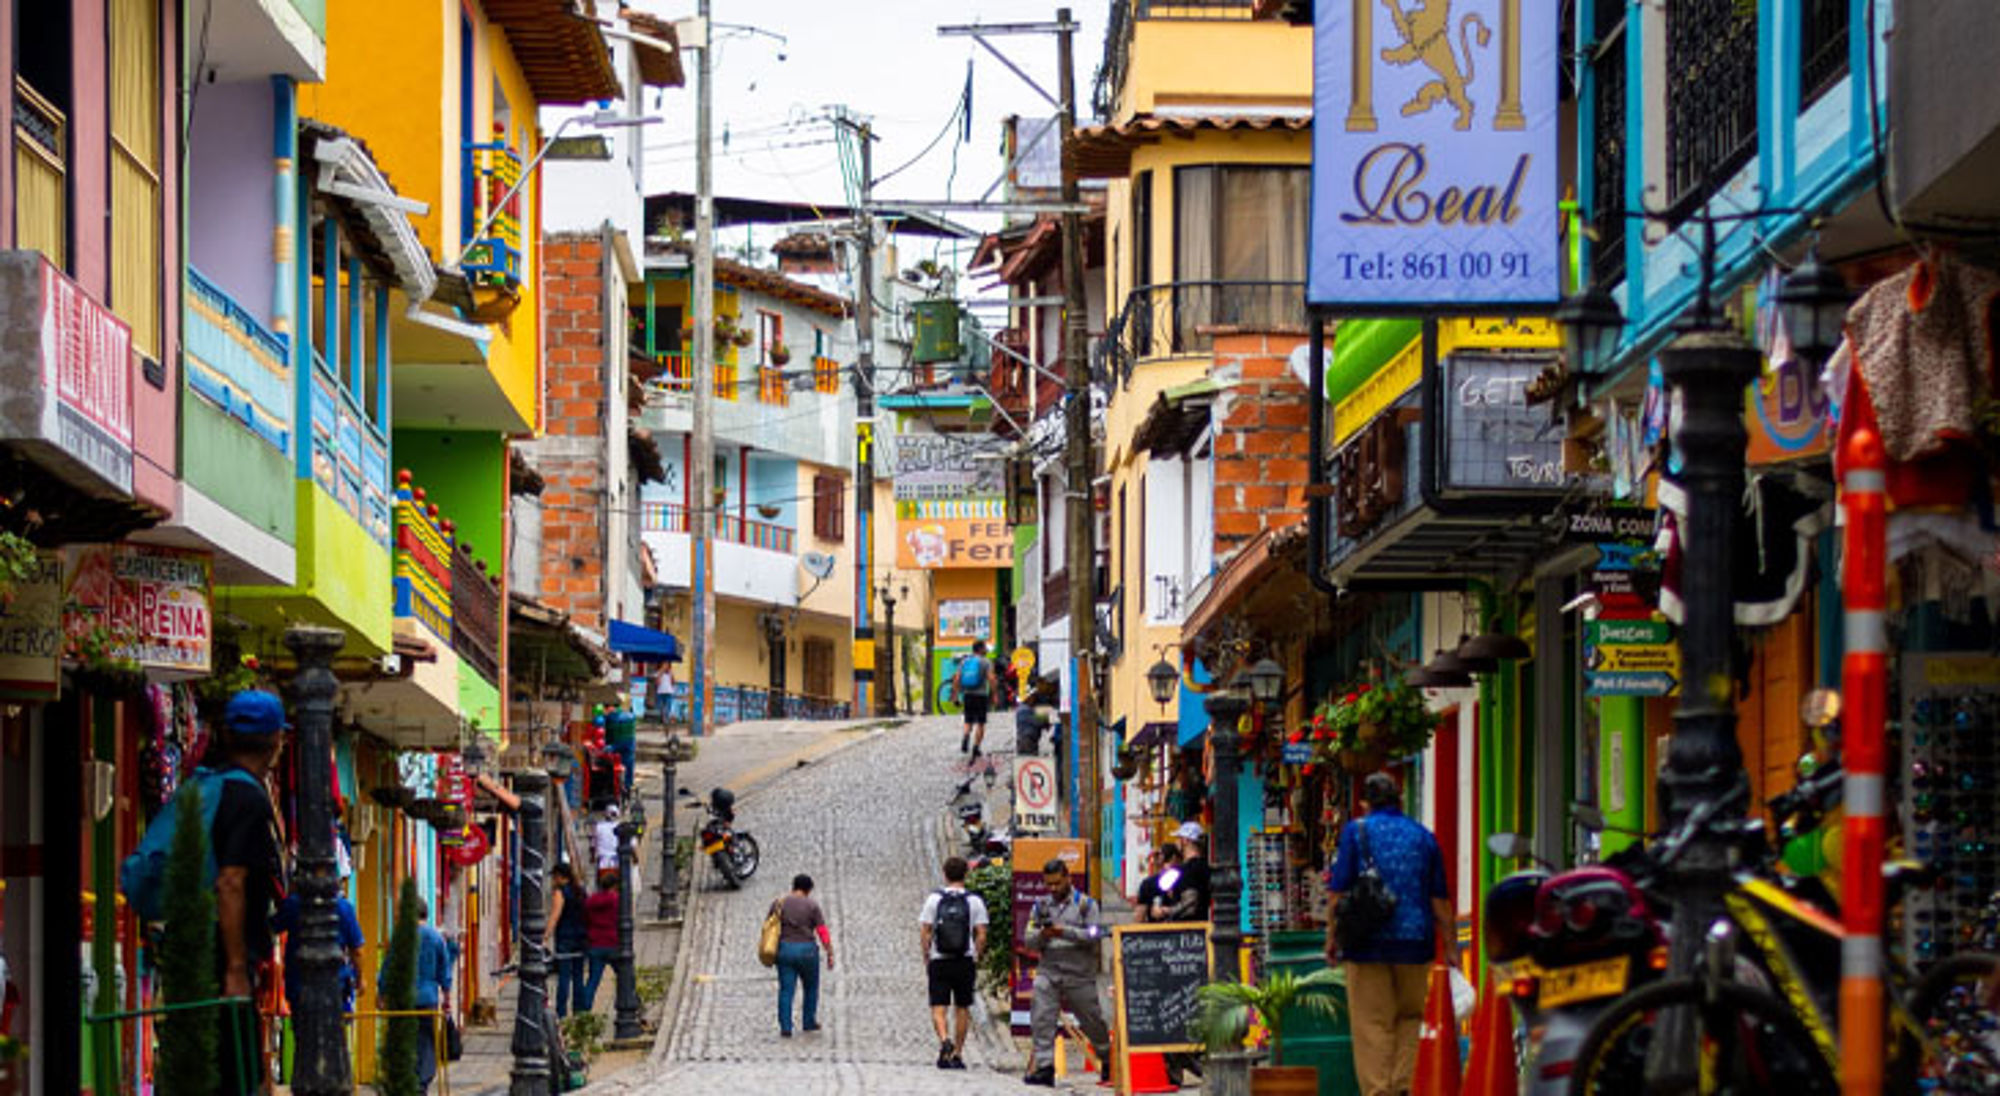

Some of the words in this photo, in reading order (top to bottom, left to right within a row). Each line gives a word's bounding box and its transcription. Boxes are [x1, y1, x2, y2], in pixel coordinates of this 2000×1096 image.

[1339, 142, 1533, 227] Real
[1337, 252, 1393, 280] Tel:
[1402, 252, 1448, 279] 861
[1459, 252, 1492, 279] 00
[1500, 252, 1530, 278] 91
[1459, 375, 1527, 406] GET
[141, 585, 207, 639] REINA
